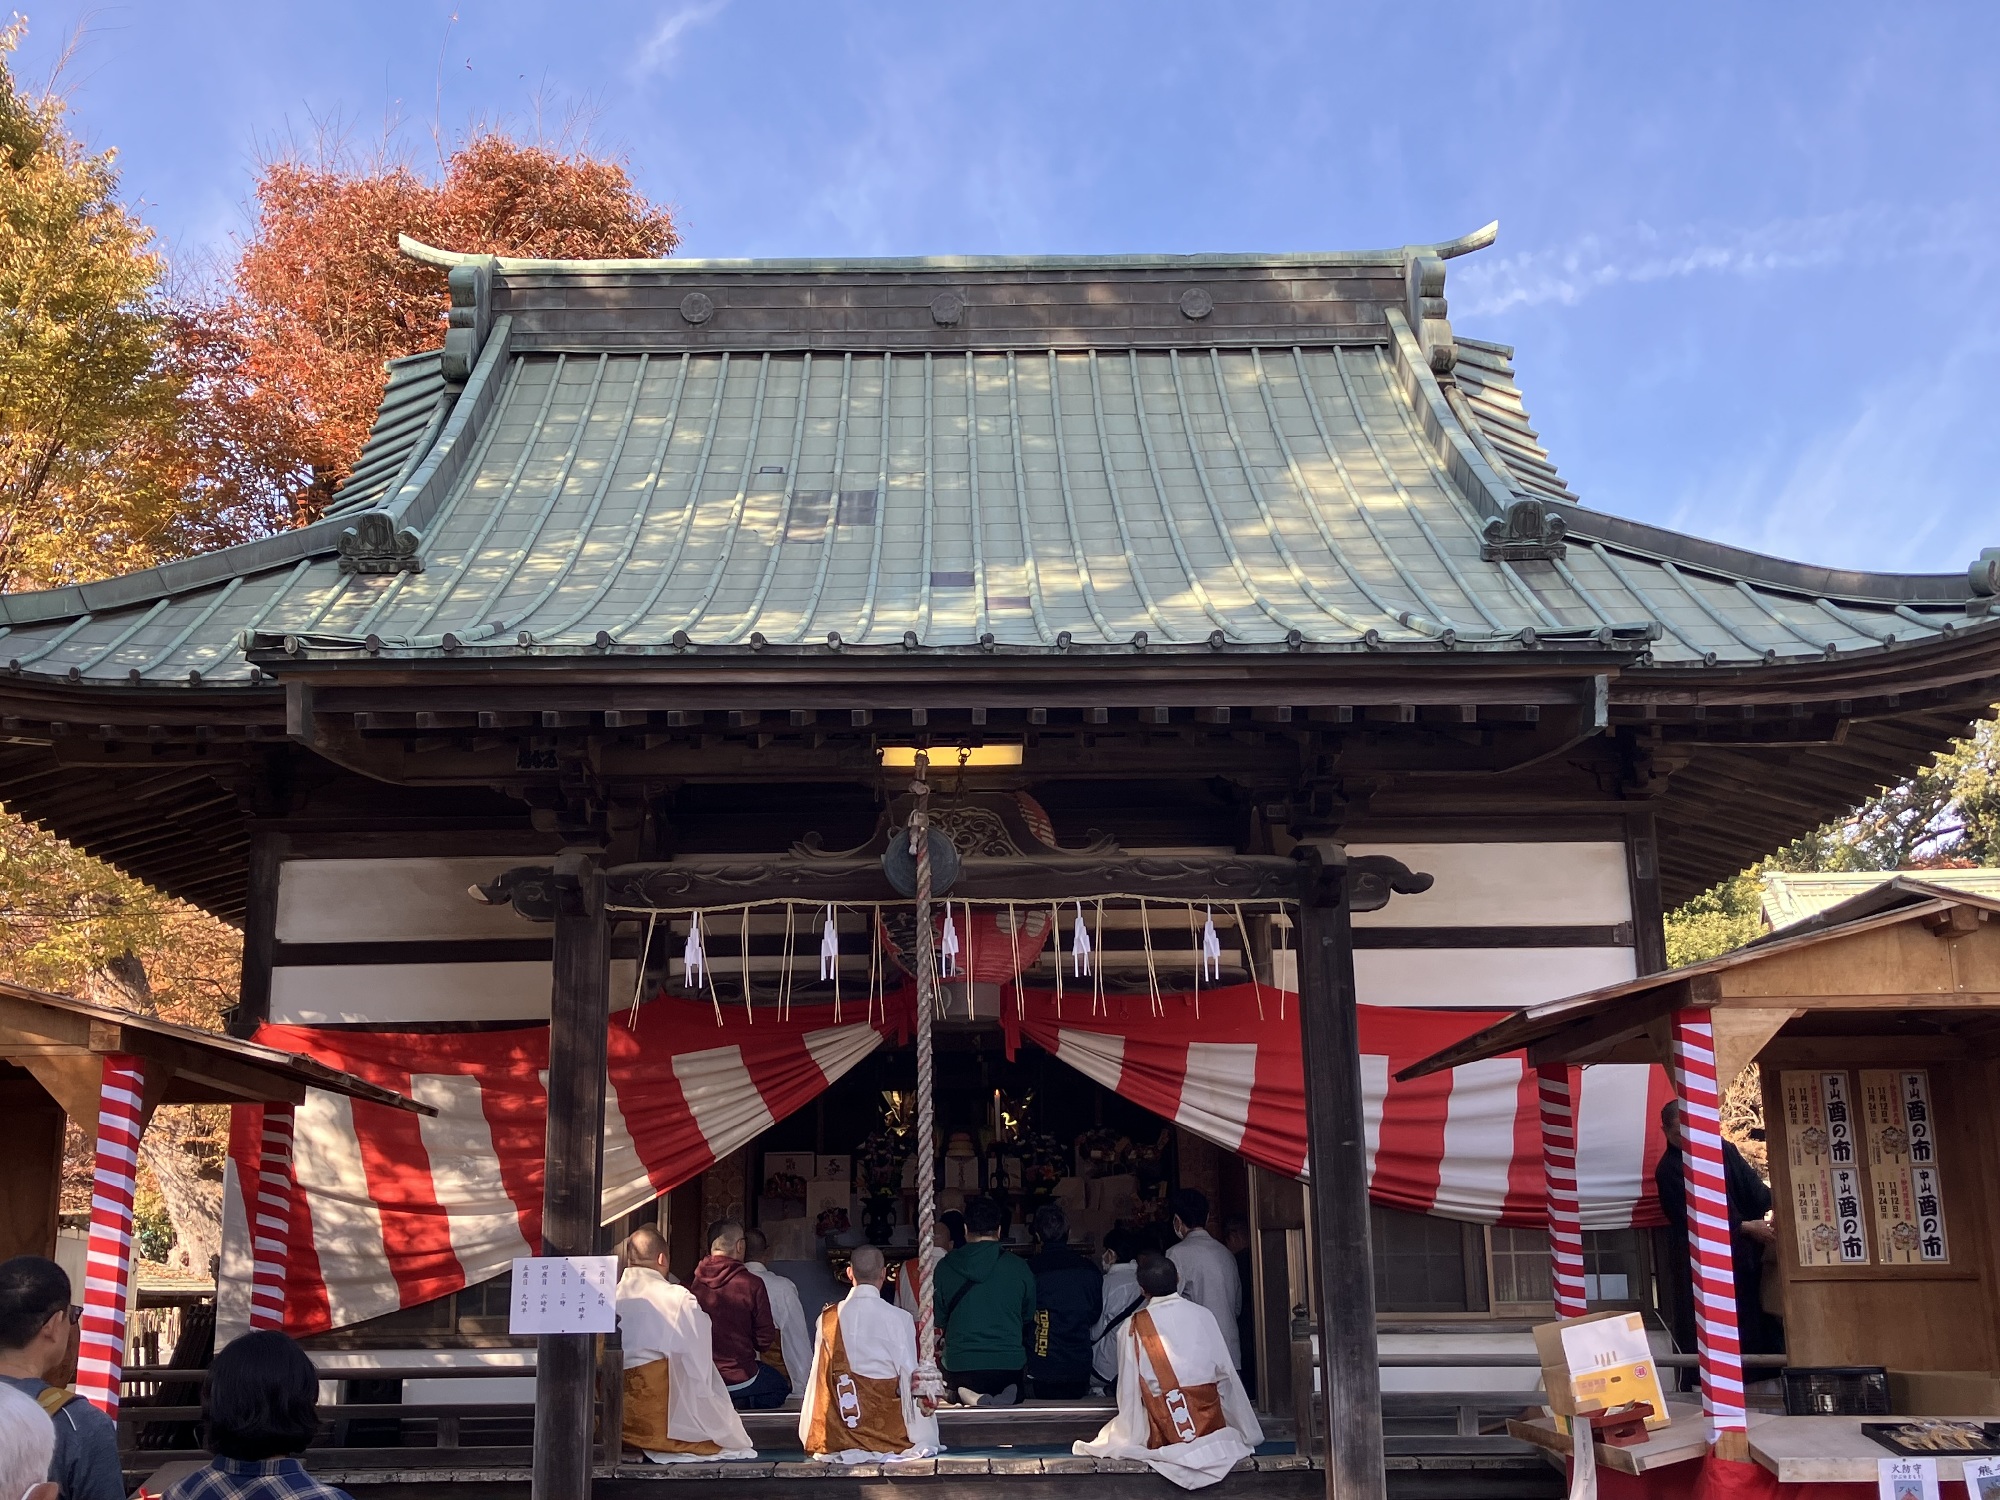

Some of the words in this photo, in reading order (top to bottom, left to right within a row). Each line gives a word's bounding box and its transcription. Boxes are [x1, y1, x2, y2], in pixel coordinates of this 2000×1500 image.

[1827, 1076, 1851, 1161] 中山酉の市
[1907, 1076, 1930, 1160] 中山酉の市
[1838, 1171, 1861, 1257] 中山酉の市
[1918, 1170, 1941, 1256] 中山酉の市
[1891, 1464, 1921, 1474] 火防守
